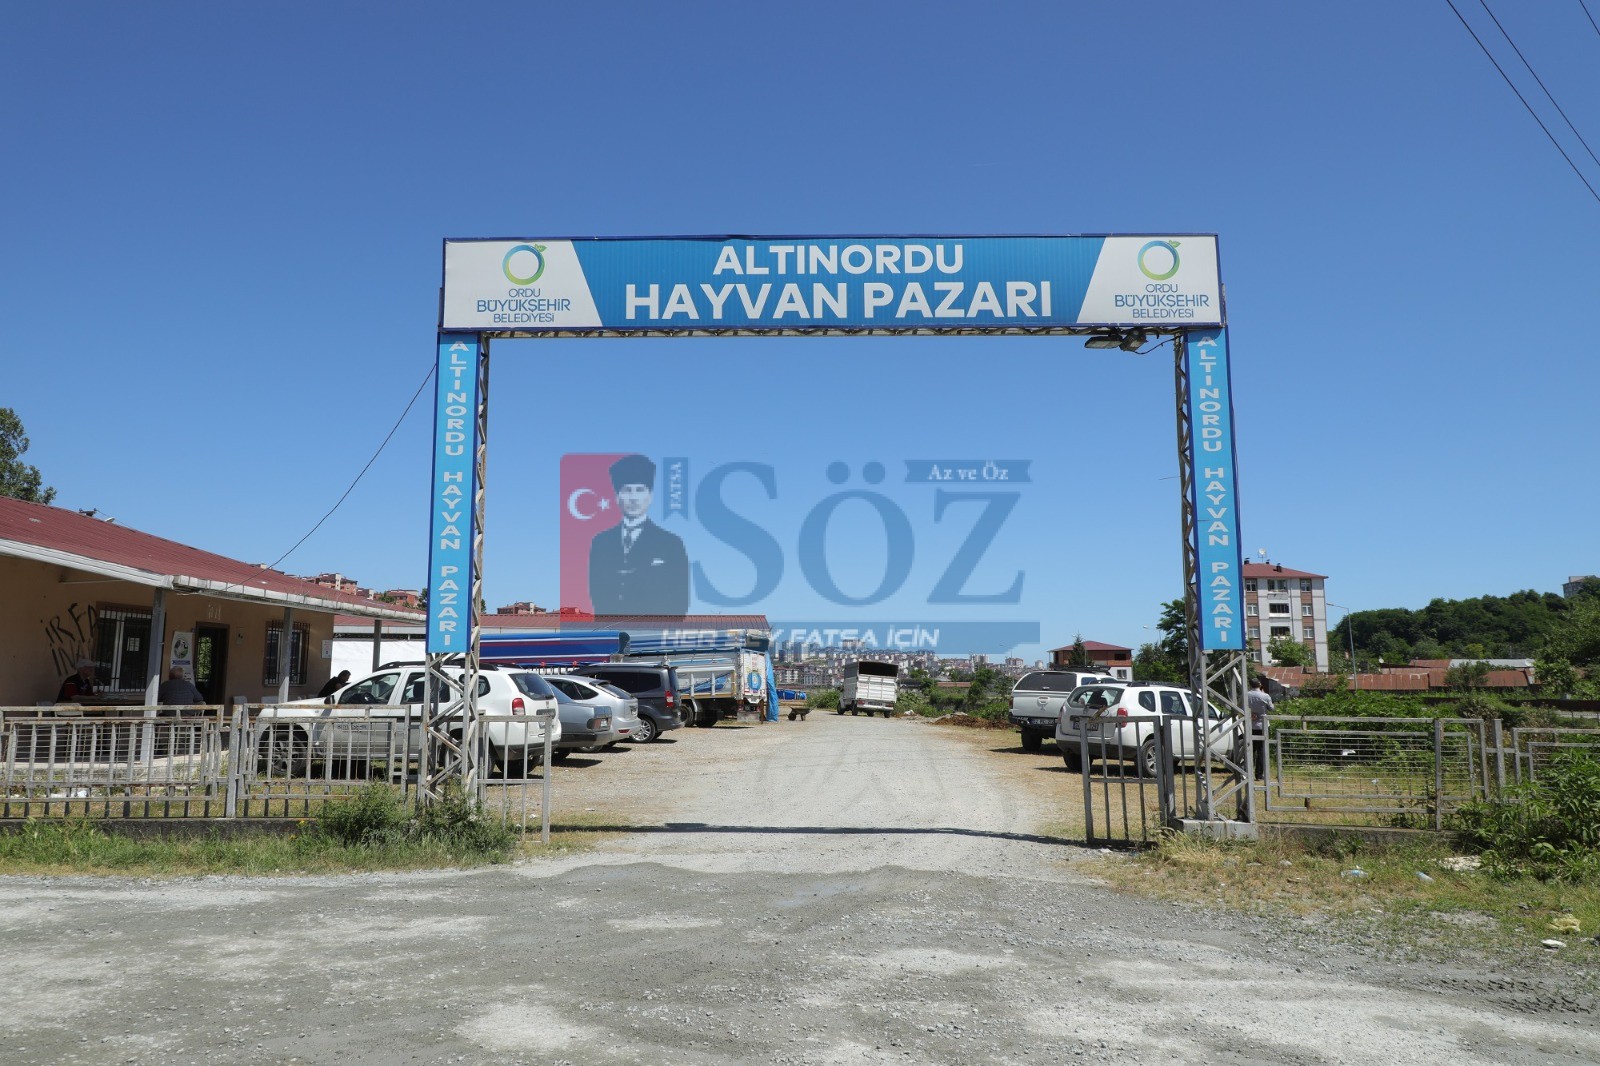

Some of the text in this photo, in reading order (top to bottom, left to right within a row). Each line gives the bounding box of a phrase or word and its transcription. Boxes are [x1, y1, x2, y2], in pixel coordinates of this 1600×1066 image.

[712, 244, 964, 276] ALTINORDU
[508, 288, 541, 298] ORDU
[1145, 283, 1178, 293] ORDU
[477, 297, 571, 314] BÜYÜKŞEHİR
[625, 280, 1051, 320] HAYVAN PAZARI
[1114, 293, 1209, 309] BÜYÜKŞEHİR
[493, 313, 555, 323] BELEDİYESİ
[1132, 308, 1194, 319] BELEDİYESİ
[437, 341, 469, 646] ALTINORDU HAYVAN PAZARI
[1196, 336, 1233, 642] ALTINORDU HAYVAN PAZARI
